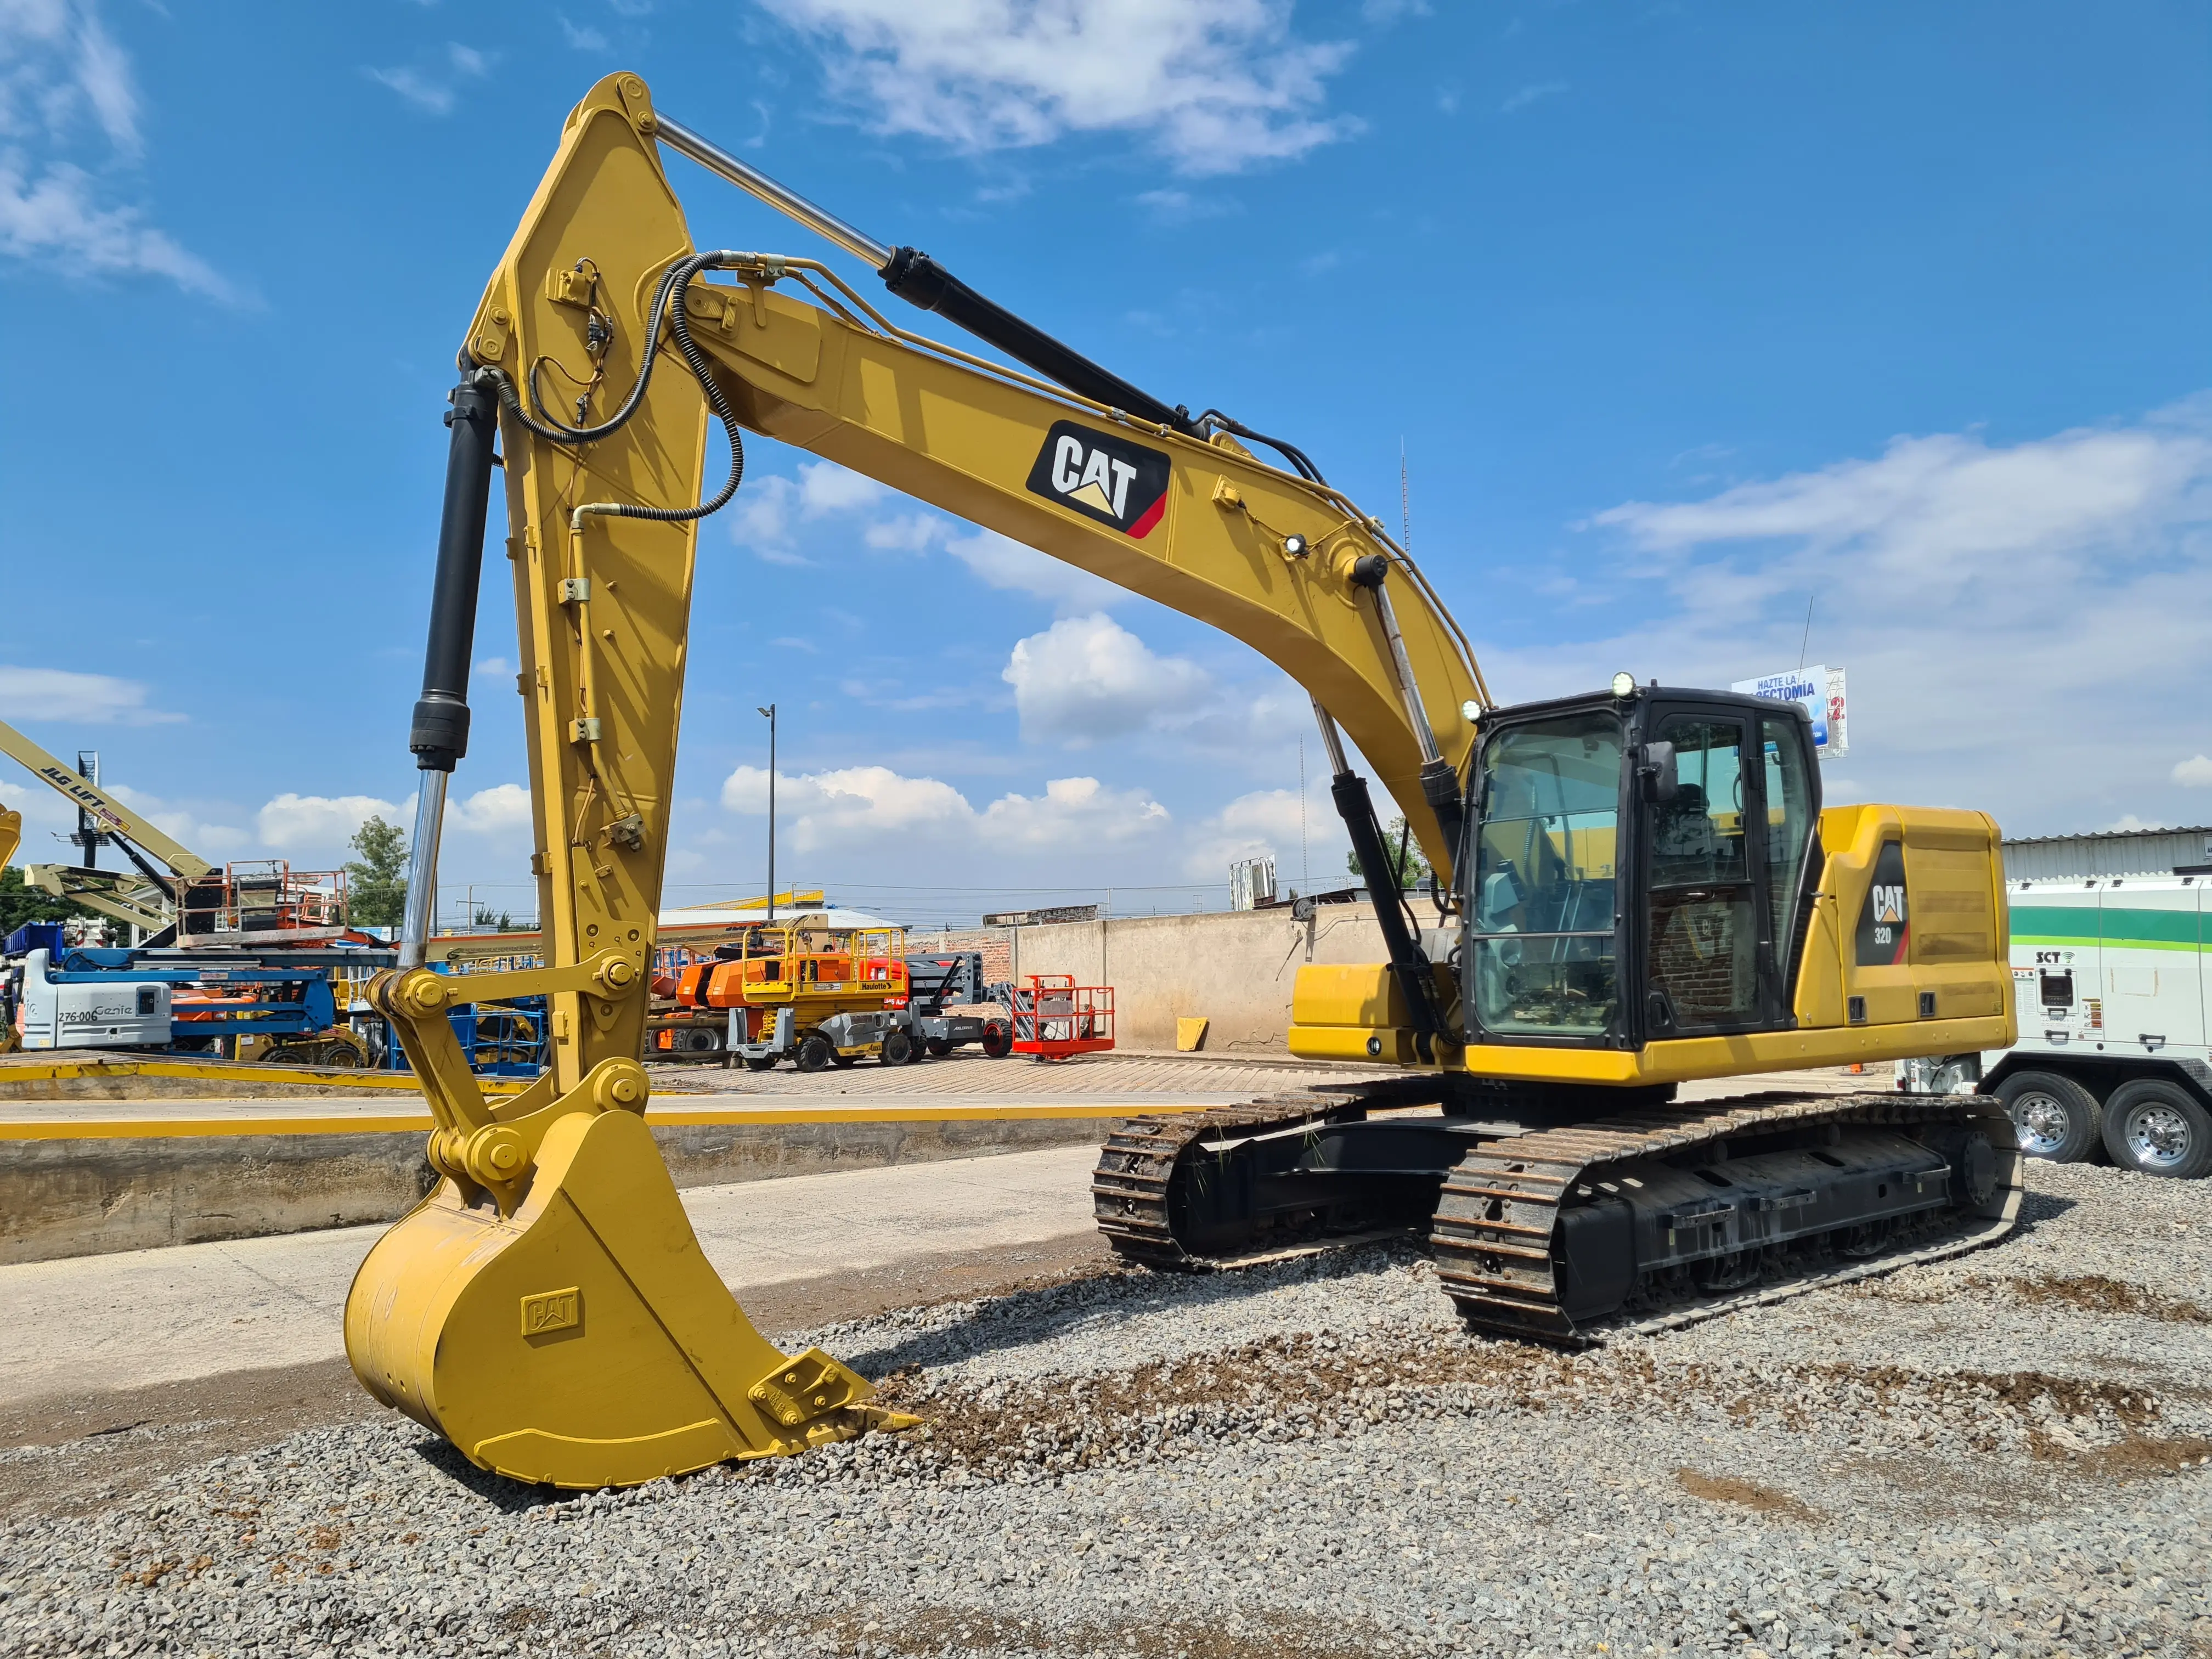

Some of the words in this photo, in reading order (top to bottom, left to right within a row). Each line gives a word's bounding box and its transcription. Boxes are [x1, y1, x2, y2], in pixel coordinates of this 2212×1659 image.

[1051, 435, 1137, 520] CAT
[1754, 680, 1815, 701] ECTOMÍA
[1758, 678, 1784, 690] HAZTE
[1786, 675, 1796, 685] LA
[40, 766, 73, 786] JLG
[69, 785, 106, 808] LIFT
[1872, 885, 1904, 922] CAT
[1875, 927, 1892, 944] 320
[2036, 951, 2061, 963] SCT
[58, 1011, 98, 1022] 276-006
[95, 1005, 133, 1015] Genie
[527, 1294, 575, 1331] CAT
